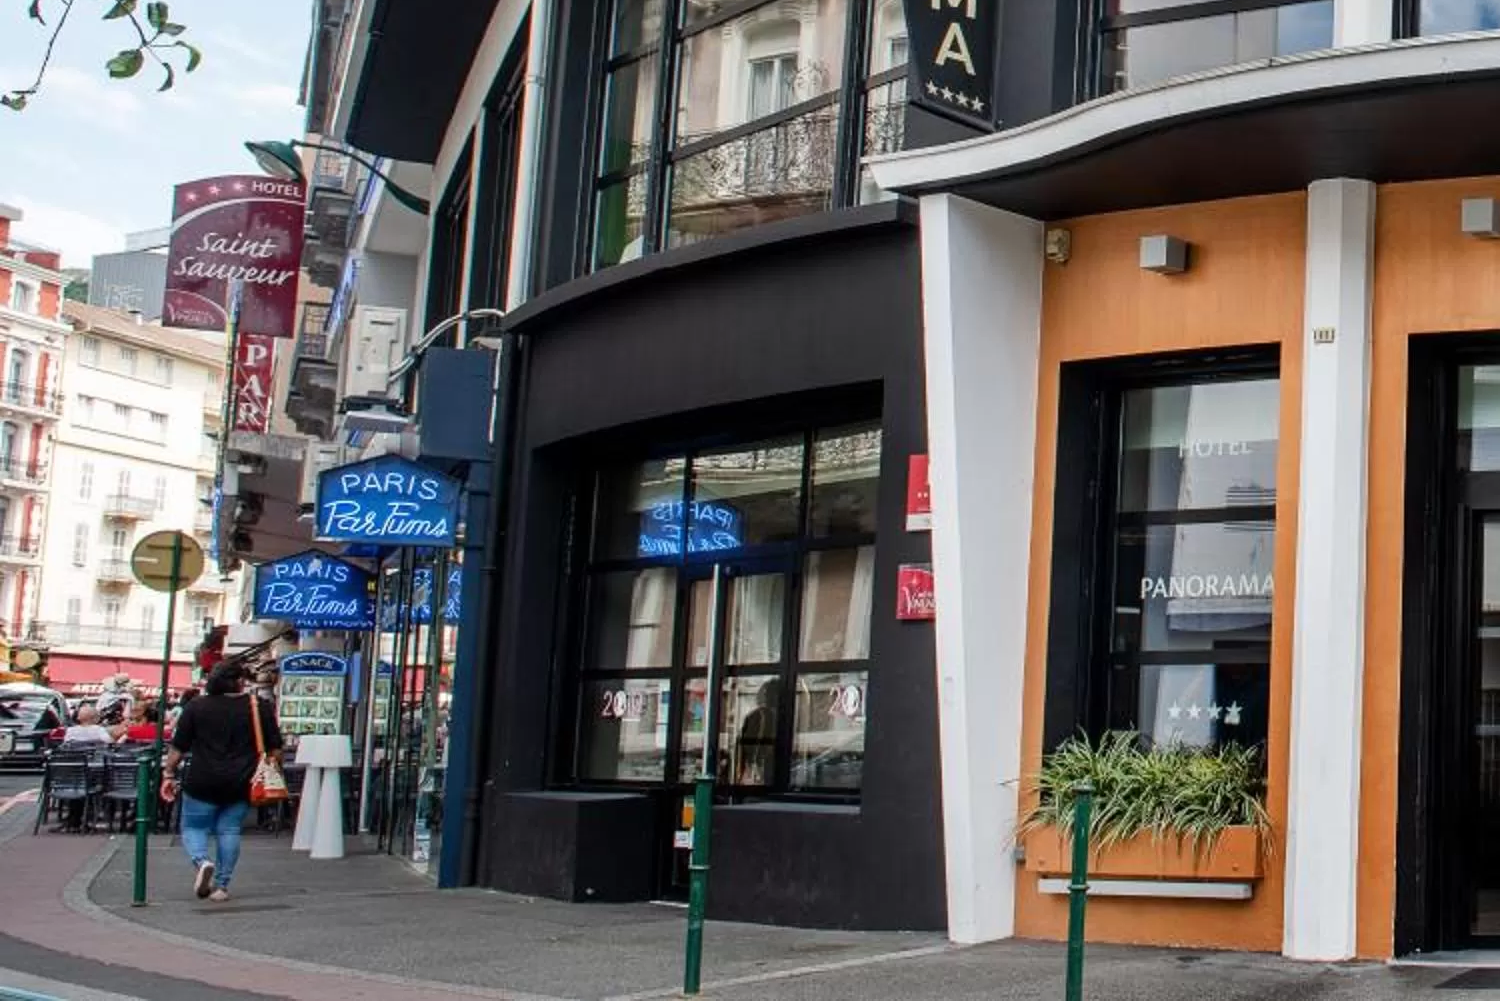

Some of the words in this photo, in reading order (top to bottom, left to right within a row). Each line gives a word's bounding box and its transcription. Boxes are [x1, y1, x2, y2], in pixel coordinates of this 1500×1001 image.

[252, 181, 302, 198] HOTEL
[196, 232, 277, 258] Saint
[173, 256, 295, 285] Sauveur
[1178, 438, 1253, 459] HOTEL
[340, 472, 440, 500] PARIS
[275, 562, 350, 582] PARIS
[1140, 574, 1275, 599] PANORAMA
